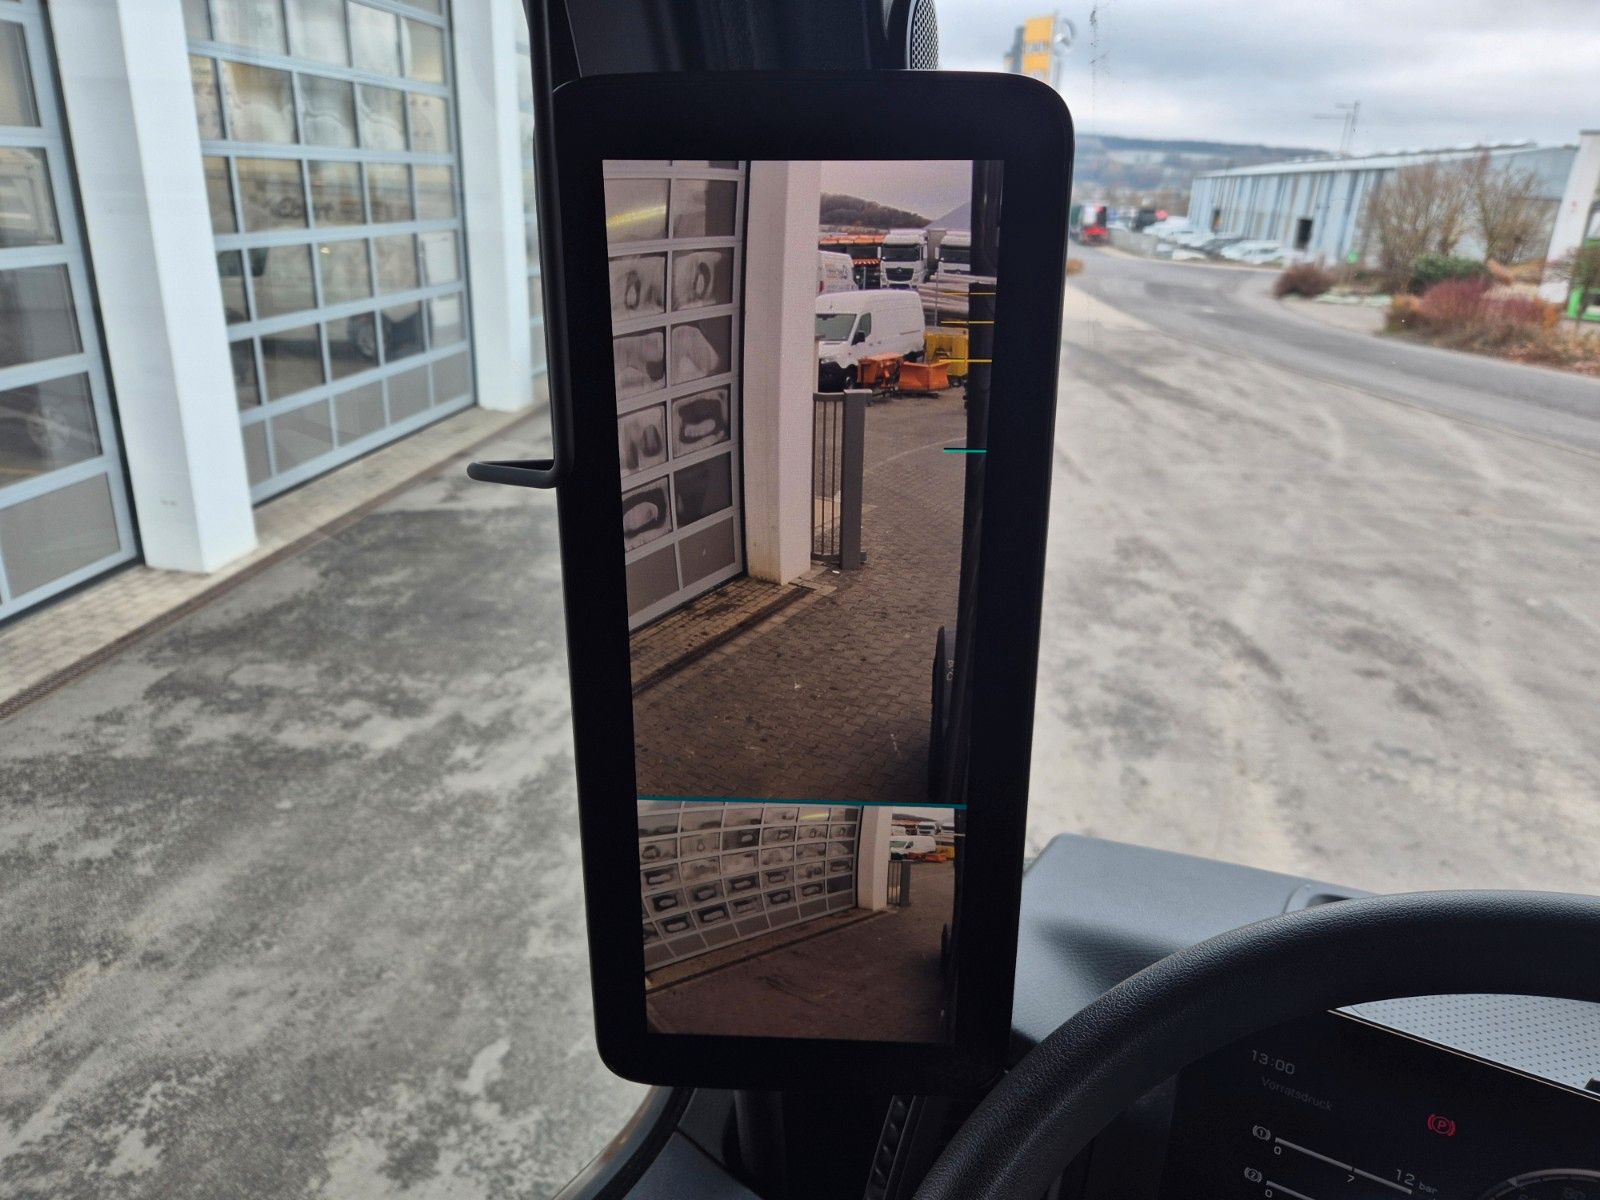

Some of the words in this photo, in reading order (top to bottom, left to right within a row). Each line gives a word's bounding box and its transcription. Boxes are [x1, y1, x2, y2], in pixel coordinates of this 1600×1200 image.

[1251, 1049, 1296, 1075] 13:00
[1262, 1076, 1333, 1111] Vorratsdruck
[1273, 1145, 1282, 1155] 0
[1264, 1189, 1273, 1198] 0
[1396, 1168, 1416, 1186] 12
[1418, 1181, 1438, 1194] bar
